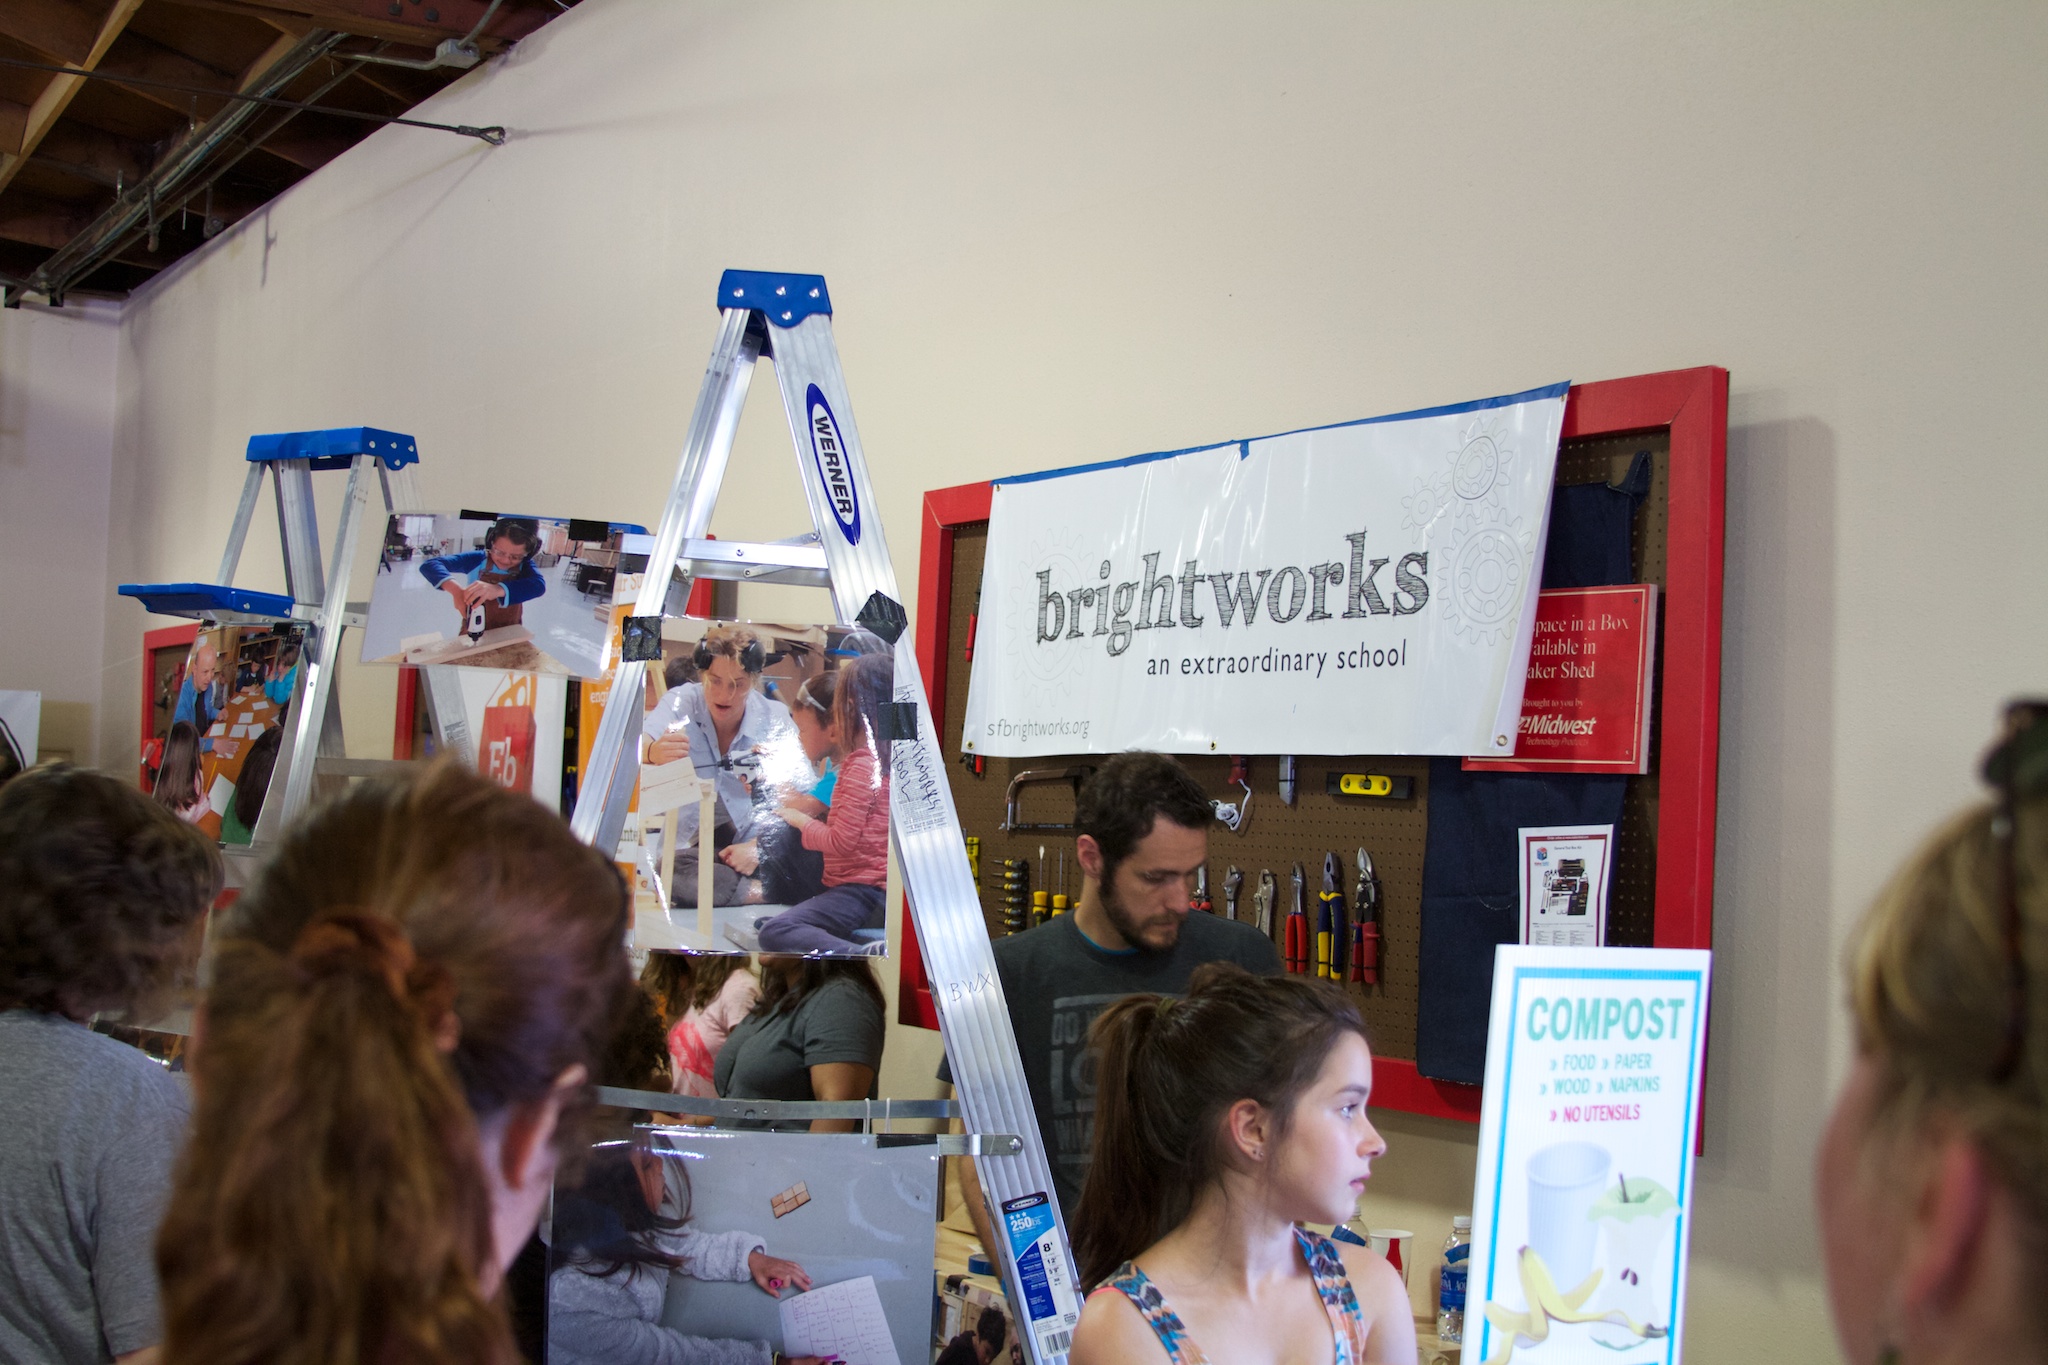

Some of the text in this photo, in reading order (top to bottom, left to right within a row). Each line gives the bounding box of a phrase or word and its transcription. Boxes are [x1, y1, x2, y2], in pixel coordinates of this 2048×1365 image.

[814, 416, 853, 515] WERNER
[1036, 526, 1430, 657] brightworks
[1571, 614, 1584, 632] in
[1587, 619, 1596, 631] a
[1531, 637, 1596, 656] ailable in
[1147, 639, 1406, 679] an extraordinary school
[1527, 660, 1595, 679] aker Shed
[987, 718, 1090, 742] sfbrightworks.org
[1527, 713, 1597, 735] Midwest
[1527, 997, 1685, 1042] COMPOST
[1563, 1053, 1652, 1071] FOOD PAPER
[1553, 1076, 1660, 1095] WOOD NAPKINS
[1563, 1104, 1640, 1122] NO UTENSILS
